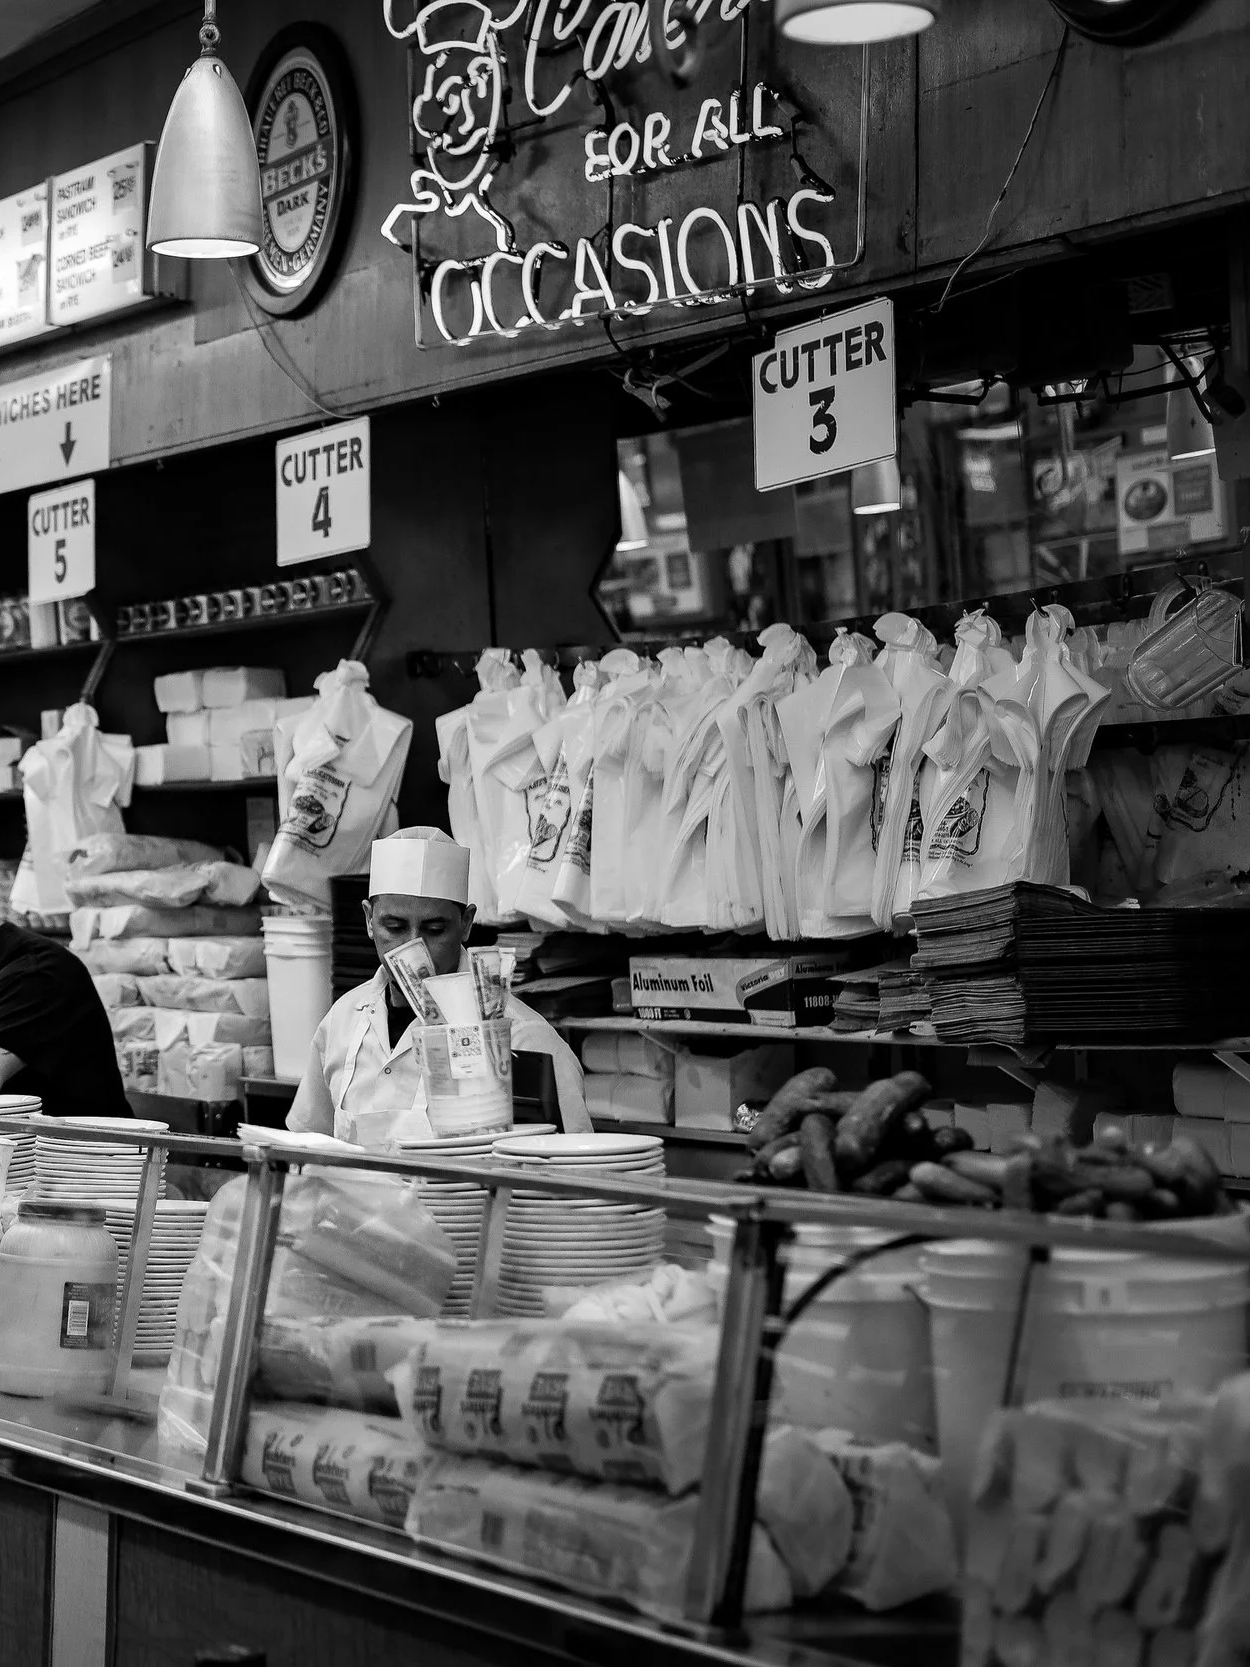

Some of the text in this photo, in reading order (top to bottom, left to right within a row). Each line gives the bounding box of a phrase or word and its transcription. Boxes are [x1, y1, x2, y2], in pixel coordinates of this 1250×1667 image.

[585, 81, 784, 182] FOR ALL
[261, 143, 328, 197] BECK'S
[276, 190, 310, 218] DARK
[432, 189, 835, 347] OCCASIONS
[758, 319, 888, 395] CUTTER
[56, 374, 101, 411] HERE
[808, 386, 838, 457] 3
[280, 434, 364, 489] CUTTER
[31, 493, 91, 538] CUTTER
[311, 486, 332, 538] 4
[53, 538, 68, 585] 5
[632, 971, 715, 994] Aluminum Foil
[739, 974, 769, 992] Victoria
